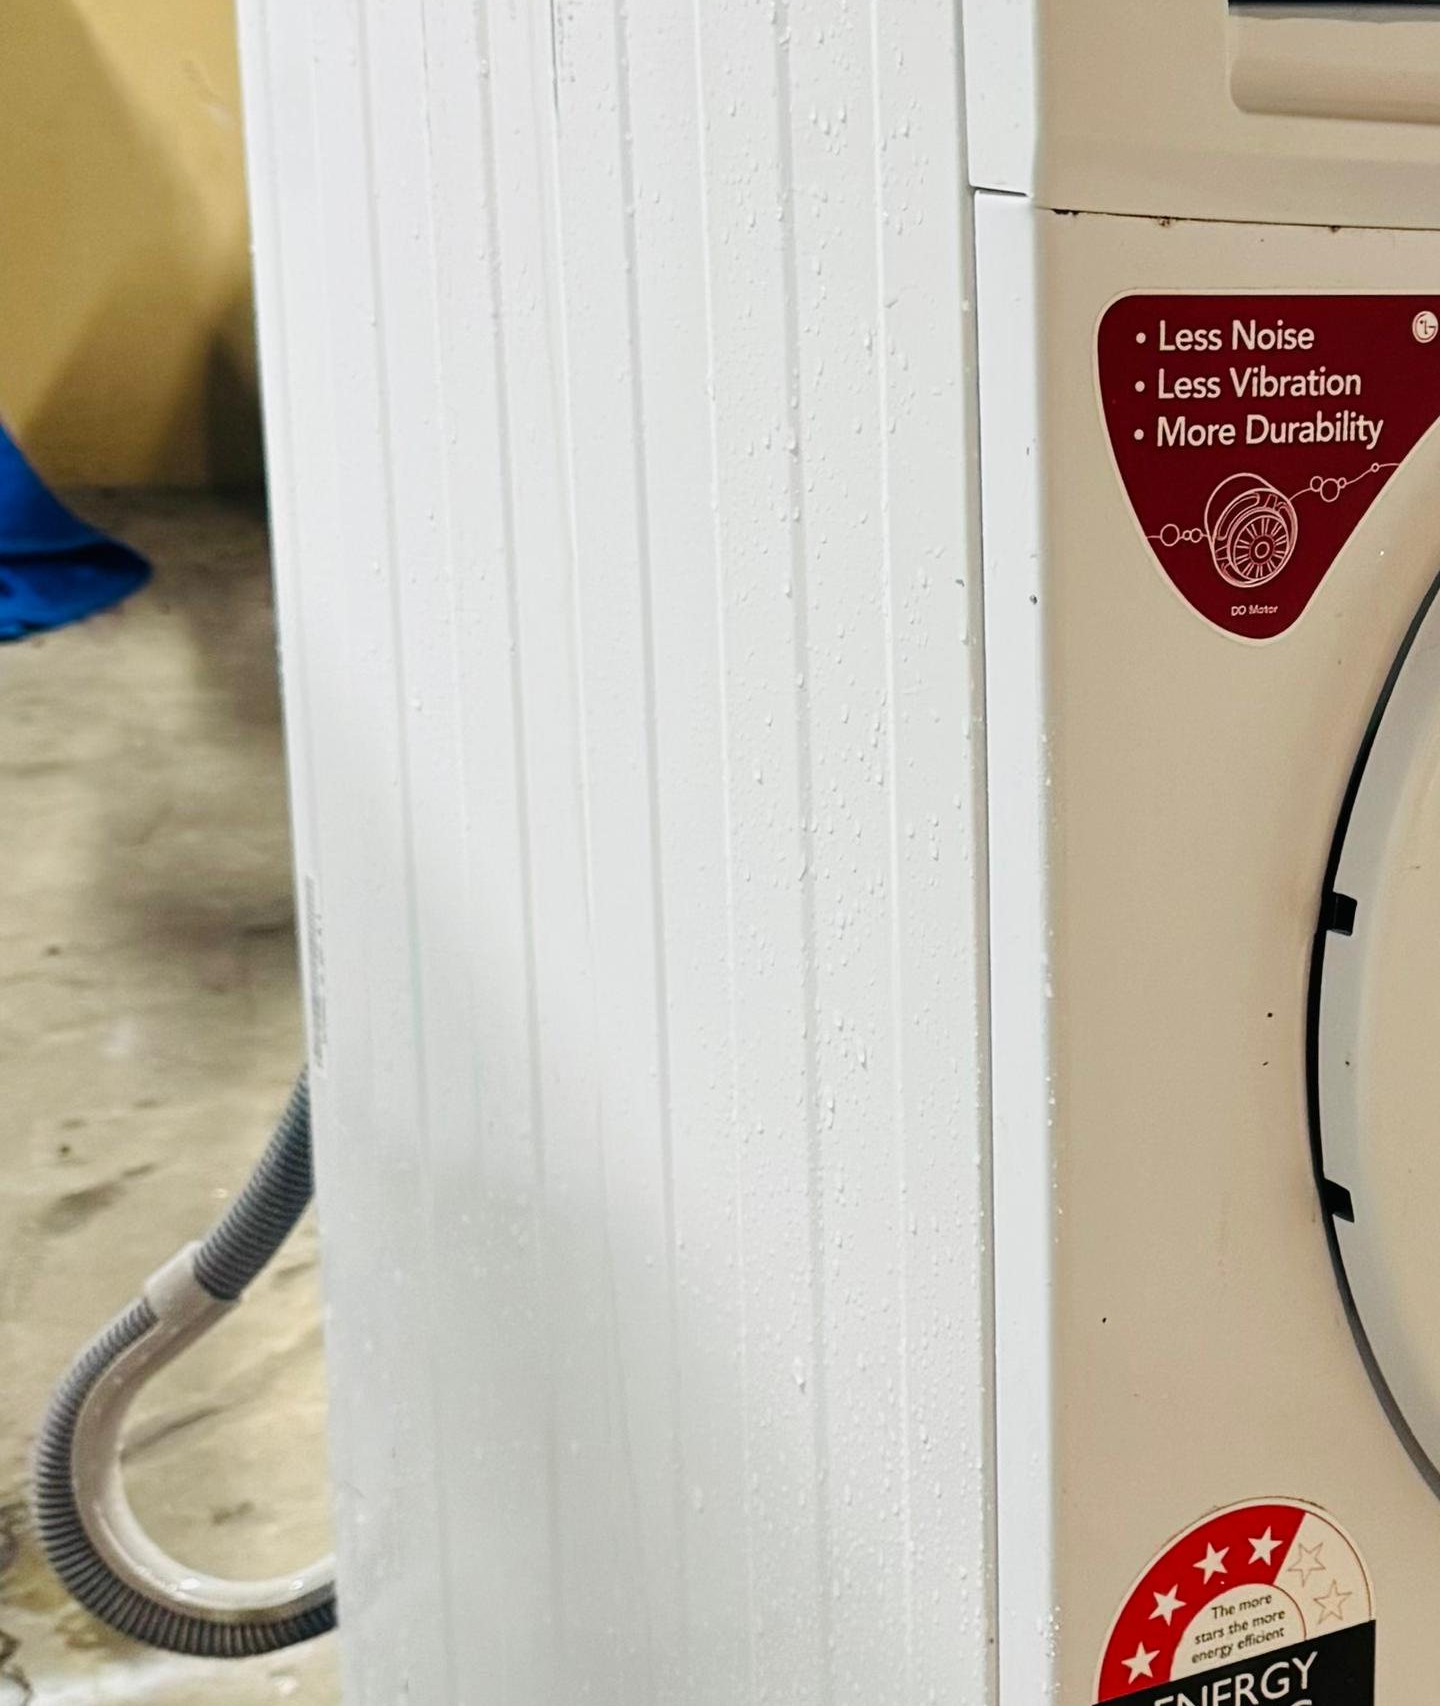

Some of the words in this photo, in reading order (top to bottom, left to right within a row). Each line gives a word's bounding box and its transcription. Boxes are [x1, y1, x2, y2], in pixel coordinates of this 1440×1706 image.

[1158, 320, 1222, 351] Less
[1231, 319, 1315, 351] Noise
[1157, 368, 1221, 399] Less
[1229, 366, 1362, 398] Vibration
[1156, 416, 1236, 447] More
[1245, 410, 1384, 450] Durability
[1211, 1604, 1236, 1620] The
[1239, 1594, 1273, 1611] more
[1194, 1627, 1225, 1645] stars
[1229, 1619, 1249, 1635] the
[1252, 1610, 1286, 1629] more
[1191, 1643, 1234, 1665] energy
[1237, 1627, 1285, 1650] efficient
